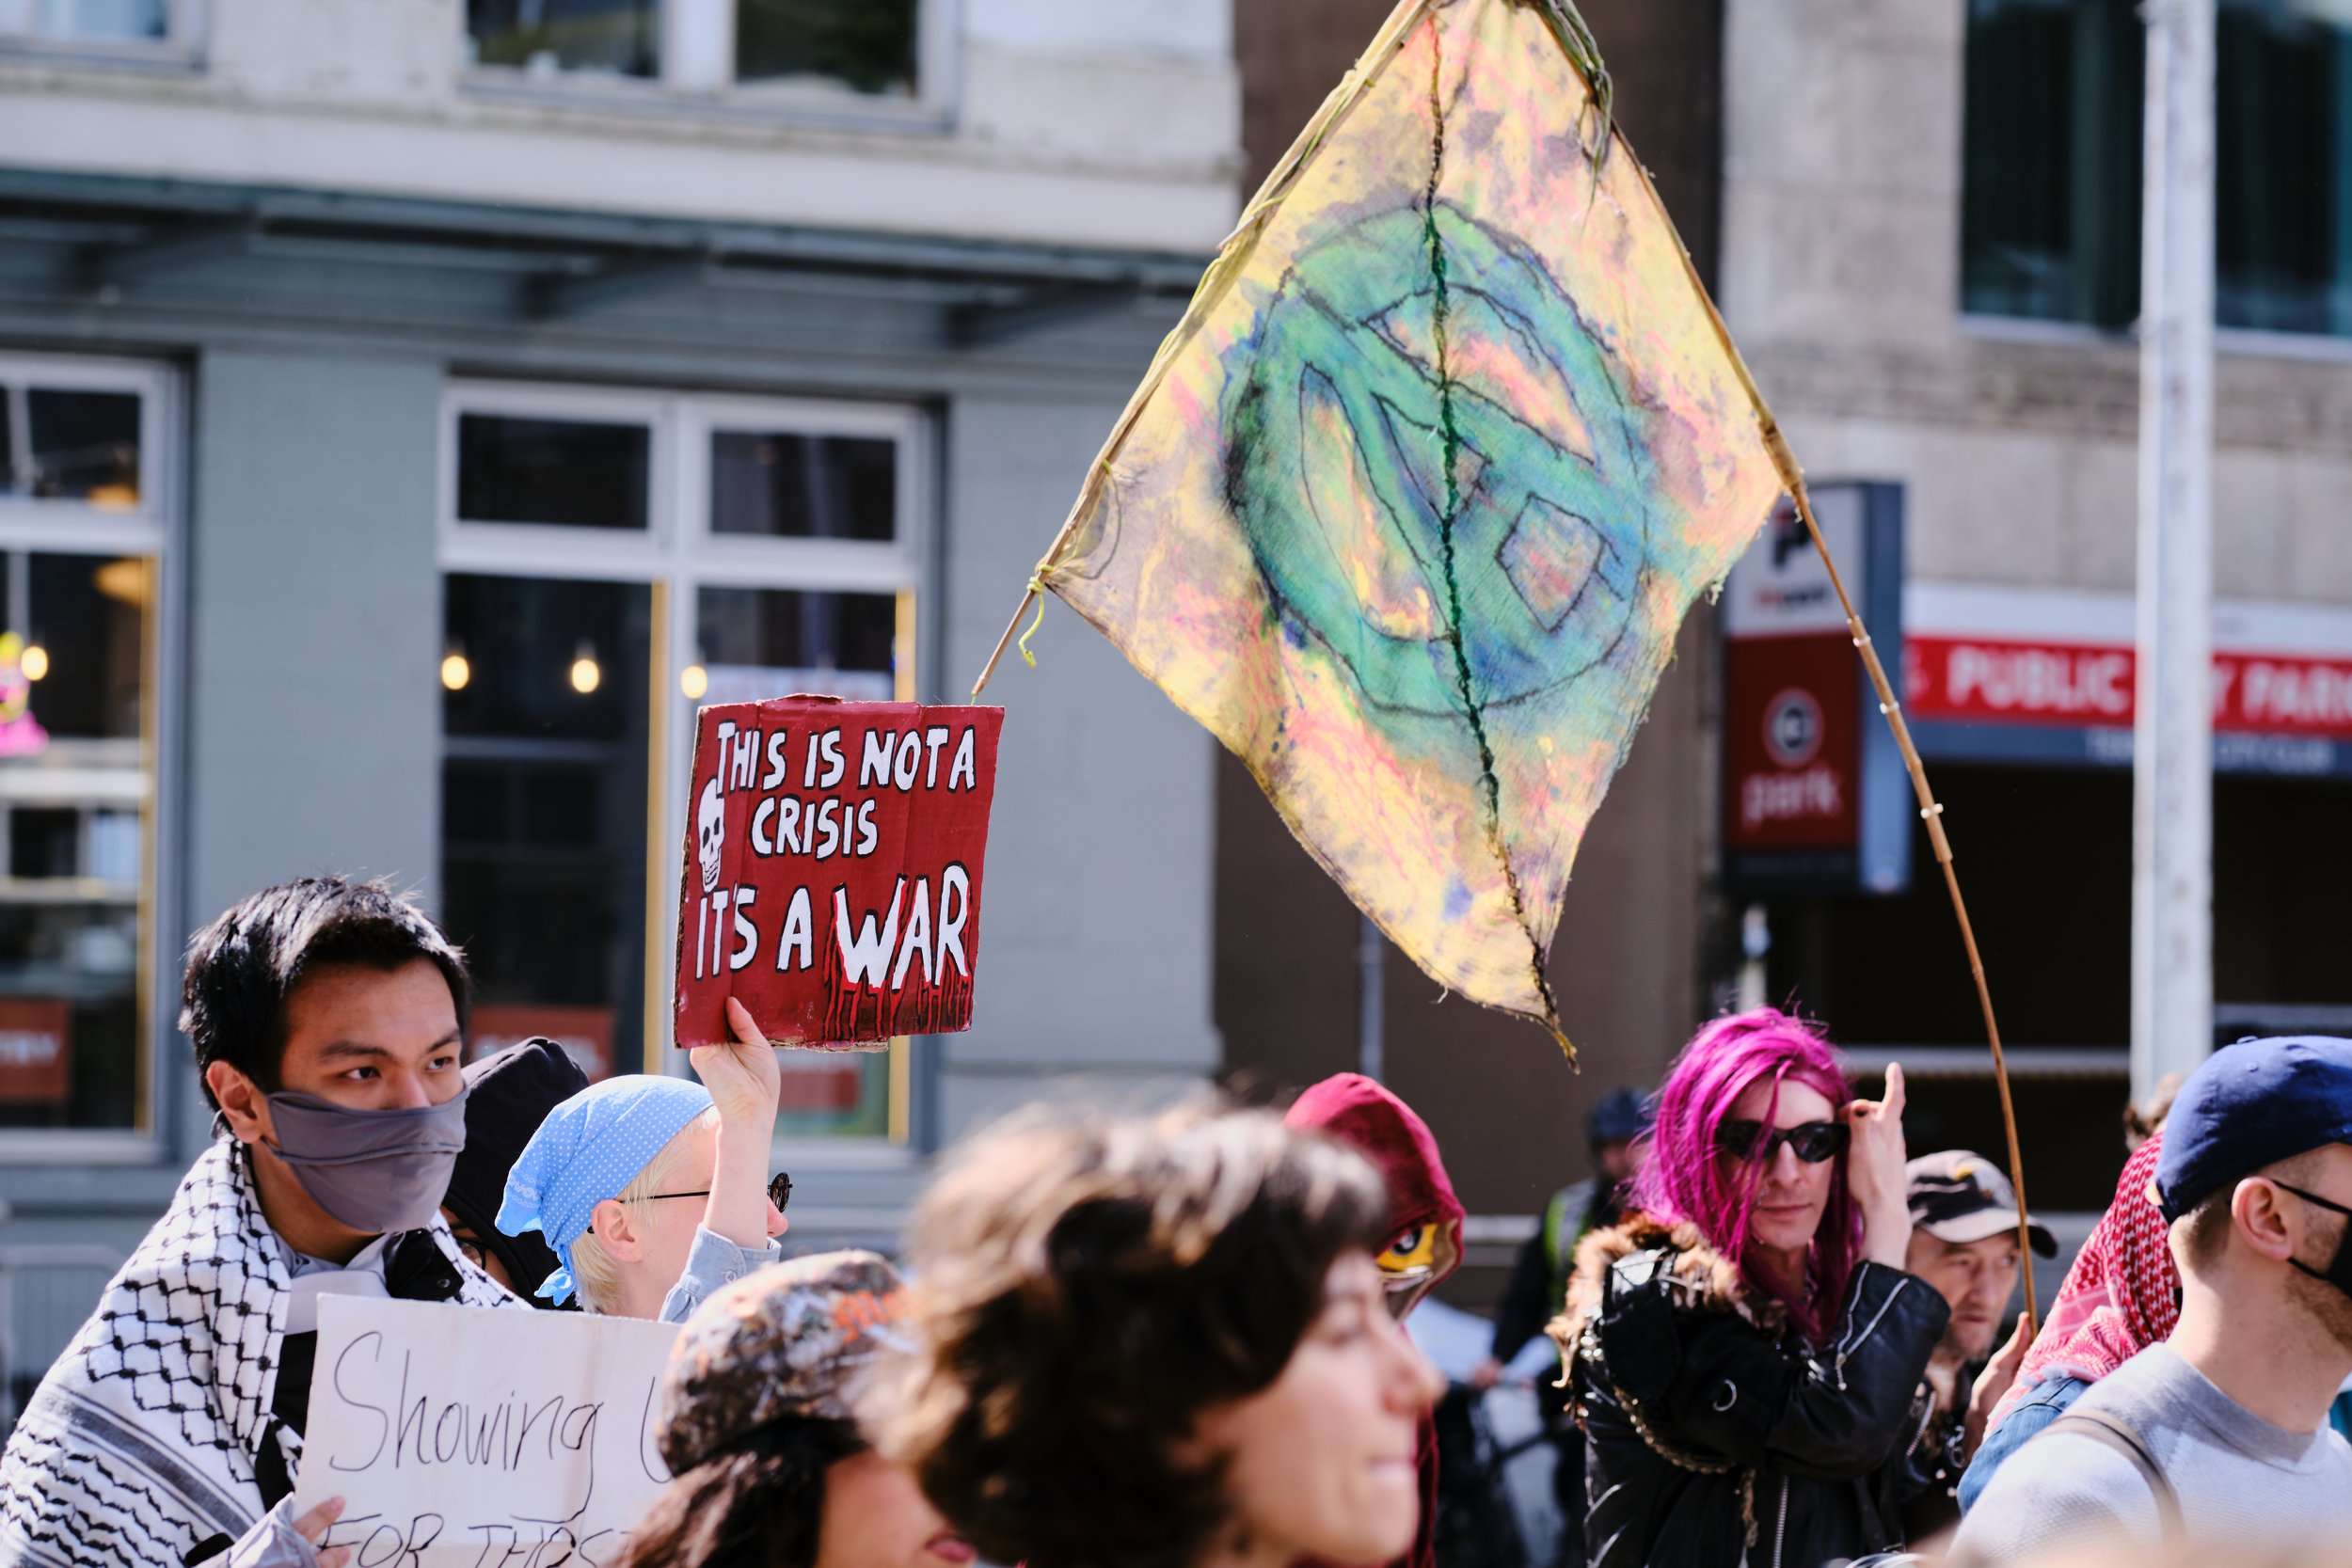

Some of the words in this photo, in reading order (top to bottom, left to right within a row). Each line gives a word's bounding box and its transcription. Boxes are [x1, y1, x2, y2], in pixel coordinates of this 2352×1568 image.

[1947, 645, 2129, 715] PUBLIC
[2243, 661, 2352, 723] PAR
[717, 720, 787, 794] THIS
[803, 726, 846, 790] IS
[858, 725, 950, 793] NOT
[948, 725, 977, 793] A
[751, 794, 879, 860] CRISIS
[1742, 766, 1840, 828] park
[695, 883, 758, 981] IT'S
[776, 885, 814, 973] A
[833, 861, 971, 993] WAR
[329, 1331, 604, 1524] Showing
[317, 1513, 444, 1568] FOR
